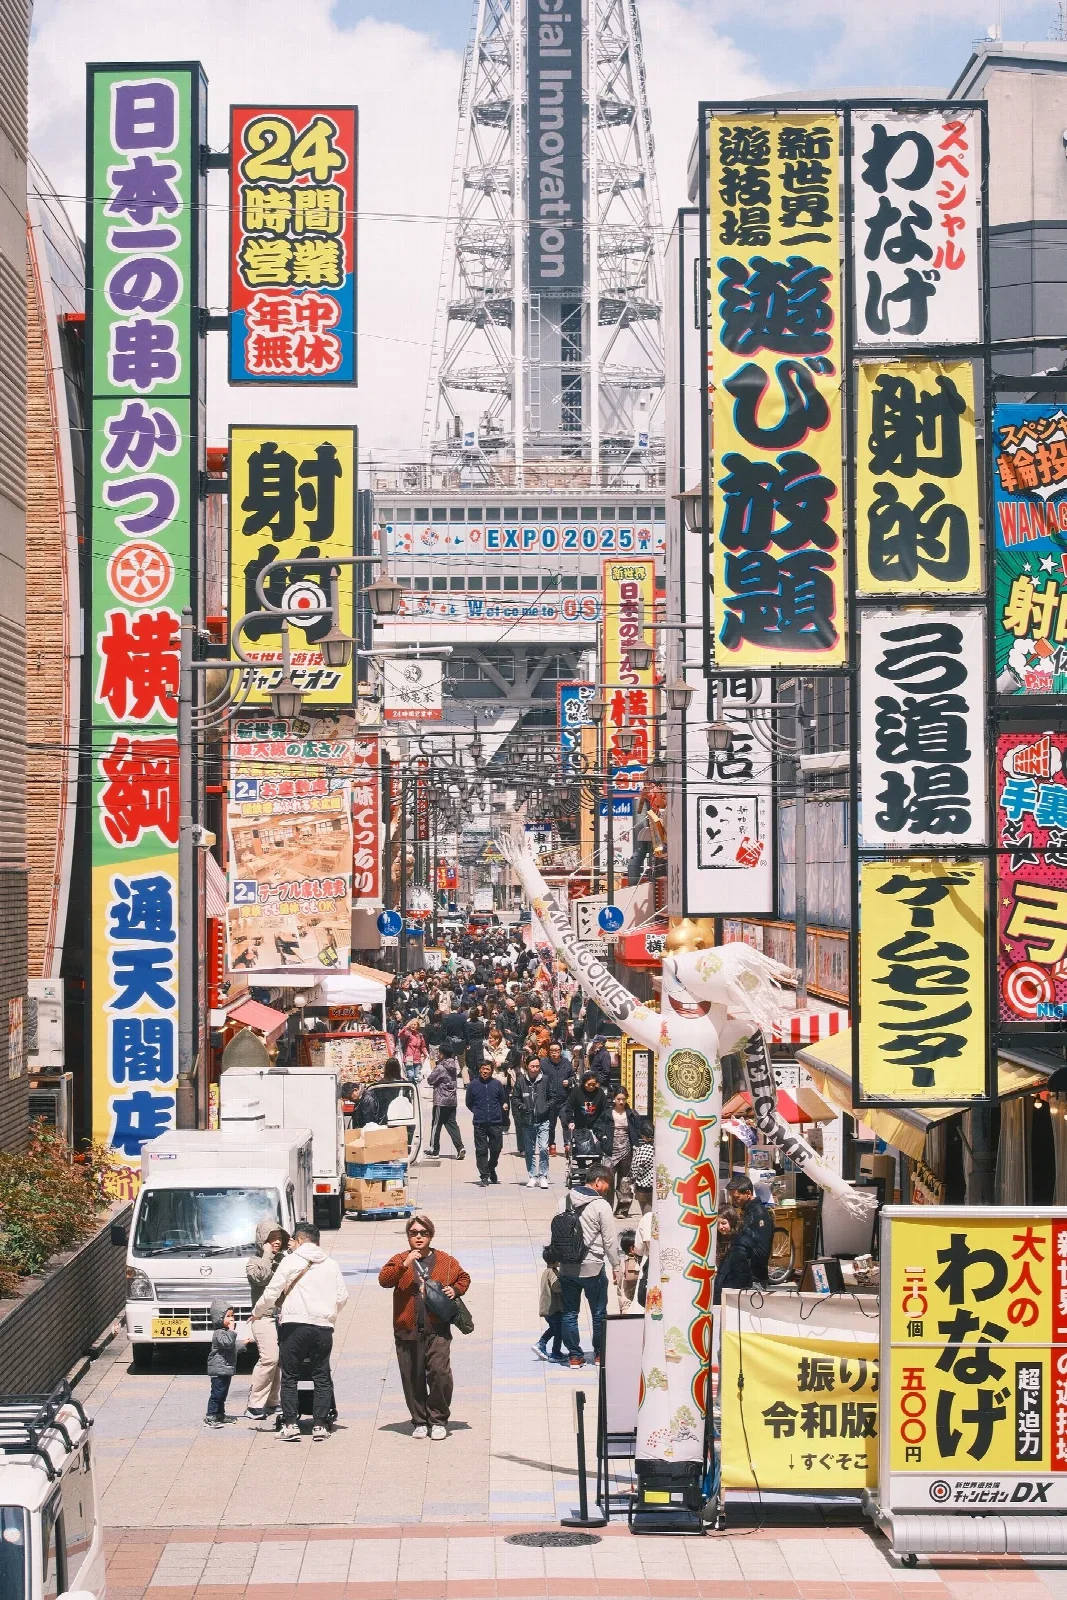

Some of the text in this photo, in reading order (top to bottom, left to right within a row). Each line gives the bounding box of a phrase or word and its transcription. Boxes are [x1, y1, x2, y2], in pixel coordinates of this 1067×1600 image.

[245, 118, 344, 181] 24
[539, 70, 573, 278] Innovation
[718, 126, 772, 247] 遊技場
[777, 126, 833, 246] 新世界一
[934, 120, 970, 271] スペシャル
[244, 239, 343, 285] 営業
[245, 189, 342, 233] 時間
[860, 123, 941, 336] わなげ
[103, 79, 180, 538] 日本一の串かつ
[251, 295, 337, 332] 年中
[251, 335, 338, 372] 無休
[716, 255, 839, 653] 遊び放題
[867, 374, 969, 583] 射的
[467, 599, 538, 617] Welcome
[541, 604, 556, 617] to
[102, 611, 180, 846] 横綱
[241, 669, 342, 690] チャンピオン
[874, 621, 973, 835] 弓道場
[1024, 672, 1054, 689] PAN!
[108, 874, 176, 1156] 通天閣店
[870, 870, 977, 1089] ゲームセンター
[743, 1028, 814, 1169] WELCOME
[670, 1108, 720, 1418] TATTOO
[1007, 1226, 1047, 1328] 大人の
[160, 1327, 188, 1337] 49-46
[934, 1233, 1012, 1463] わなげ
[761, 1401, 878, 1439] 令和版
[802, 1453, 870, 1471] すぐそこ
[900, 1367, 927, 1464] 五〇〇円
[1018, 1367, 1041, 1456] 超ド迫力
[953, 1482, 1054, 1503] チャンピオン DX
